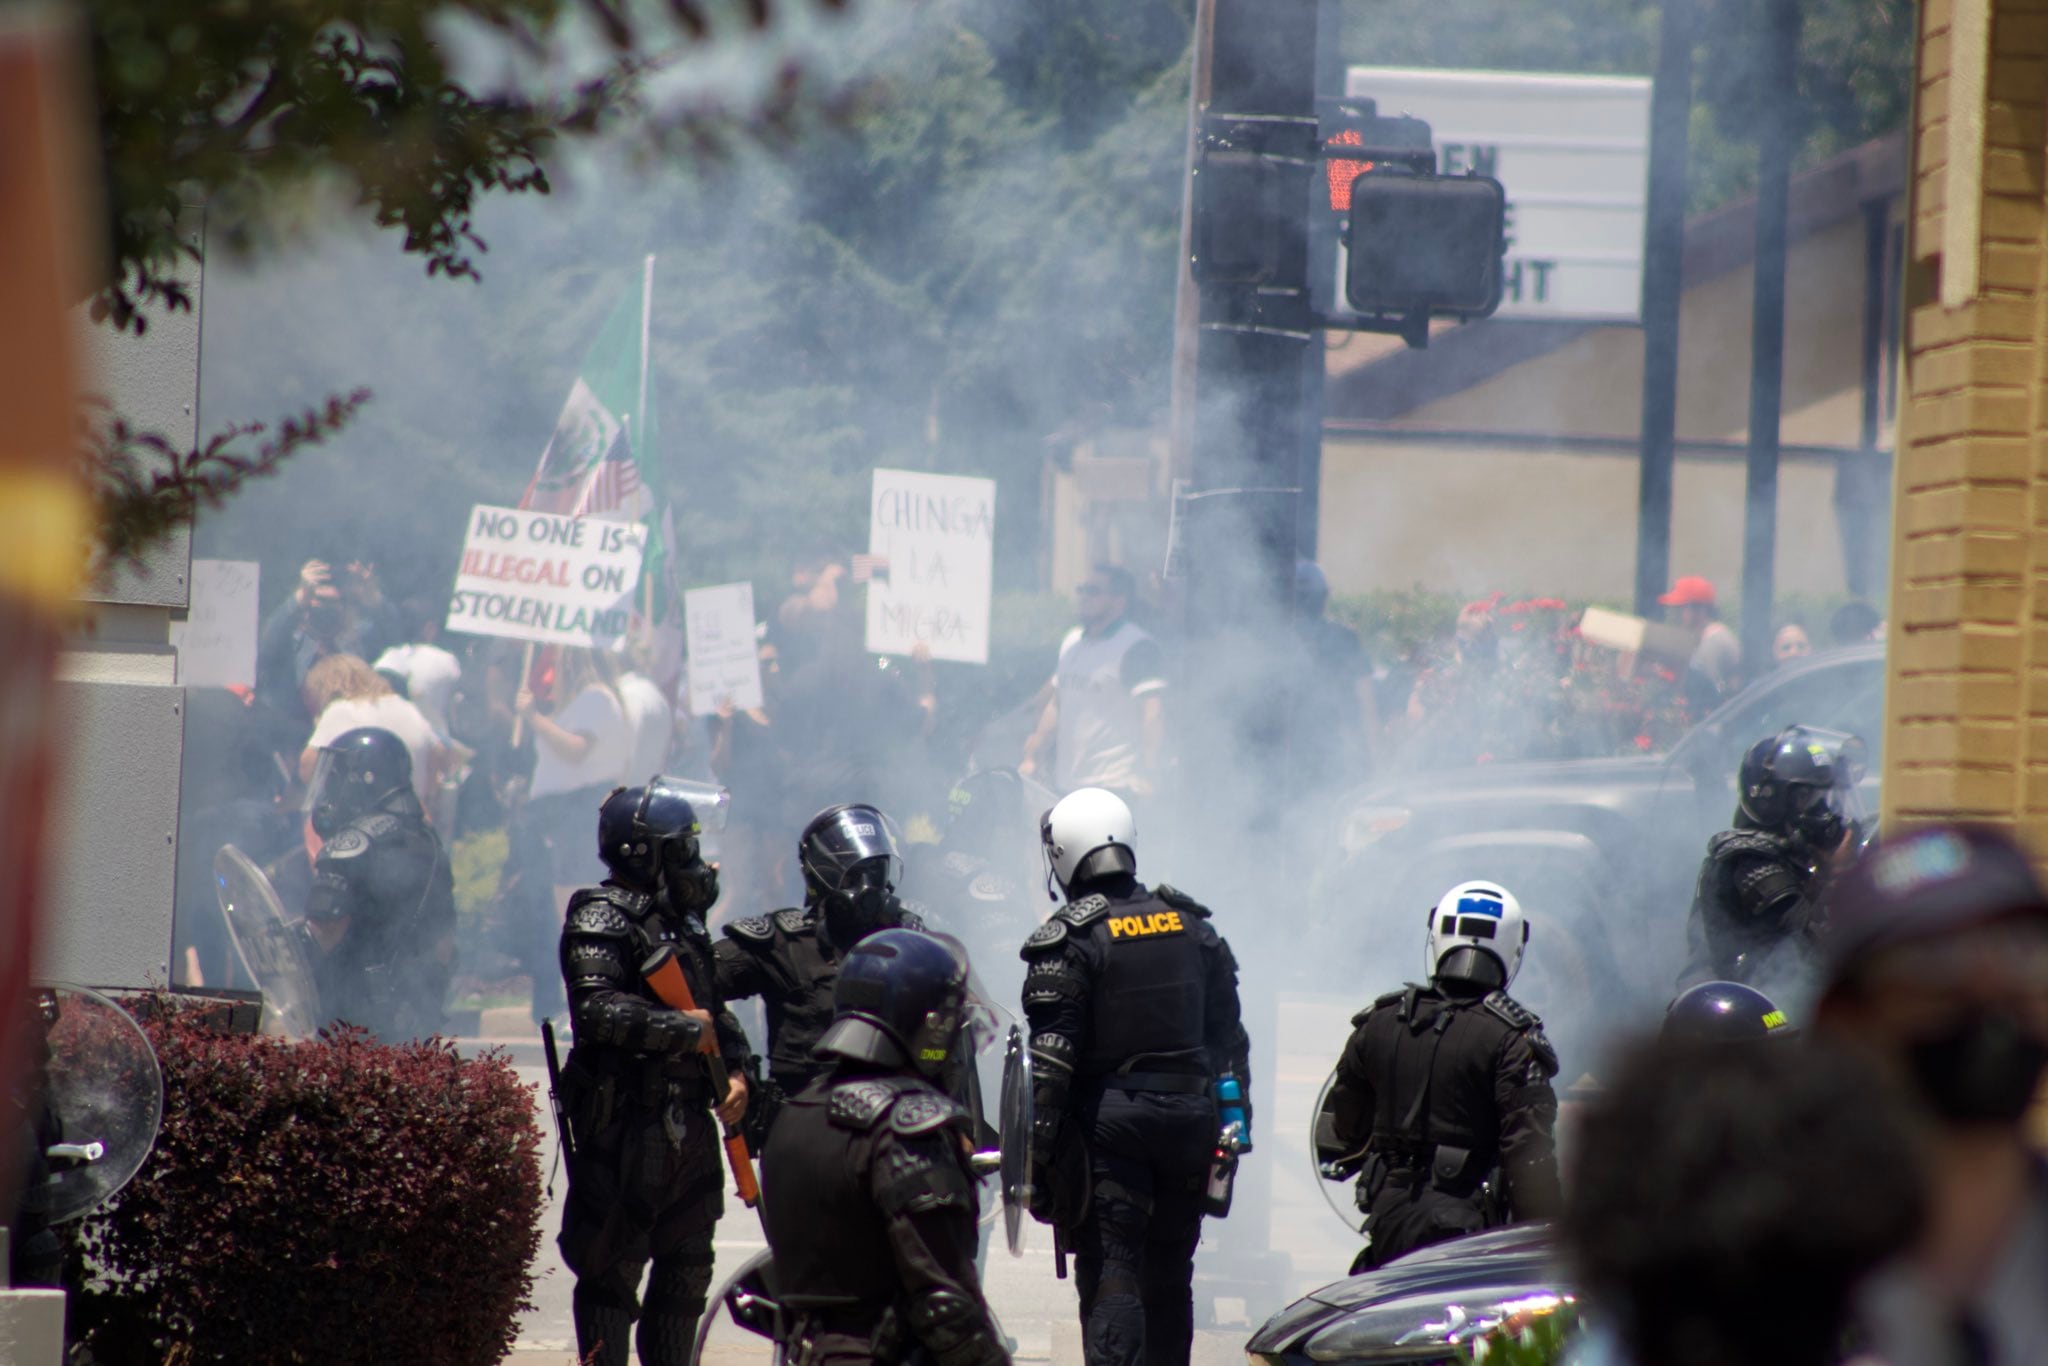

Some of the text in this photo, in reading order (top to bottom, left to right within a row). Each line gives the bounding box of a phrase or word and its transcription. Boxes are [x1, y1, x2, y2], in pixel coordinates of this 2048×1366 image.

[476, 511, 626, 552] NO ONE IS
[877, 487, 992, 541] CHINGA
[461, 549, 625, 592] ILLEGAL ON
[910, 547, 949, 588] LA
[450, 590, 629, 635] STOLEN LAND
[880, 601, 973, 645] MIGRA
[1108, 911, 1184, 938] POLICE
